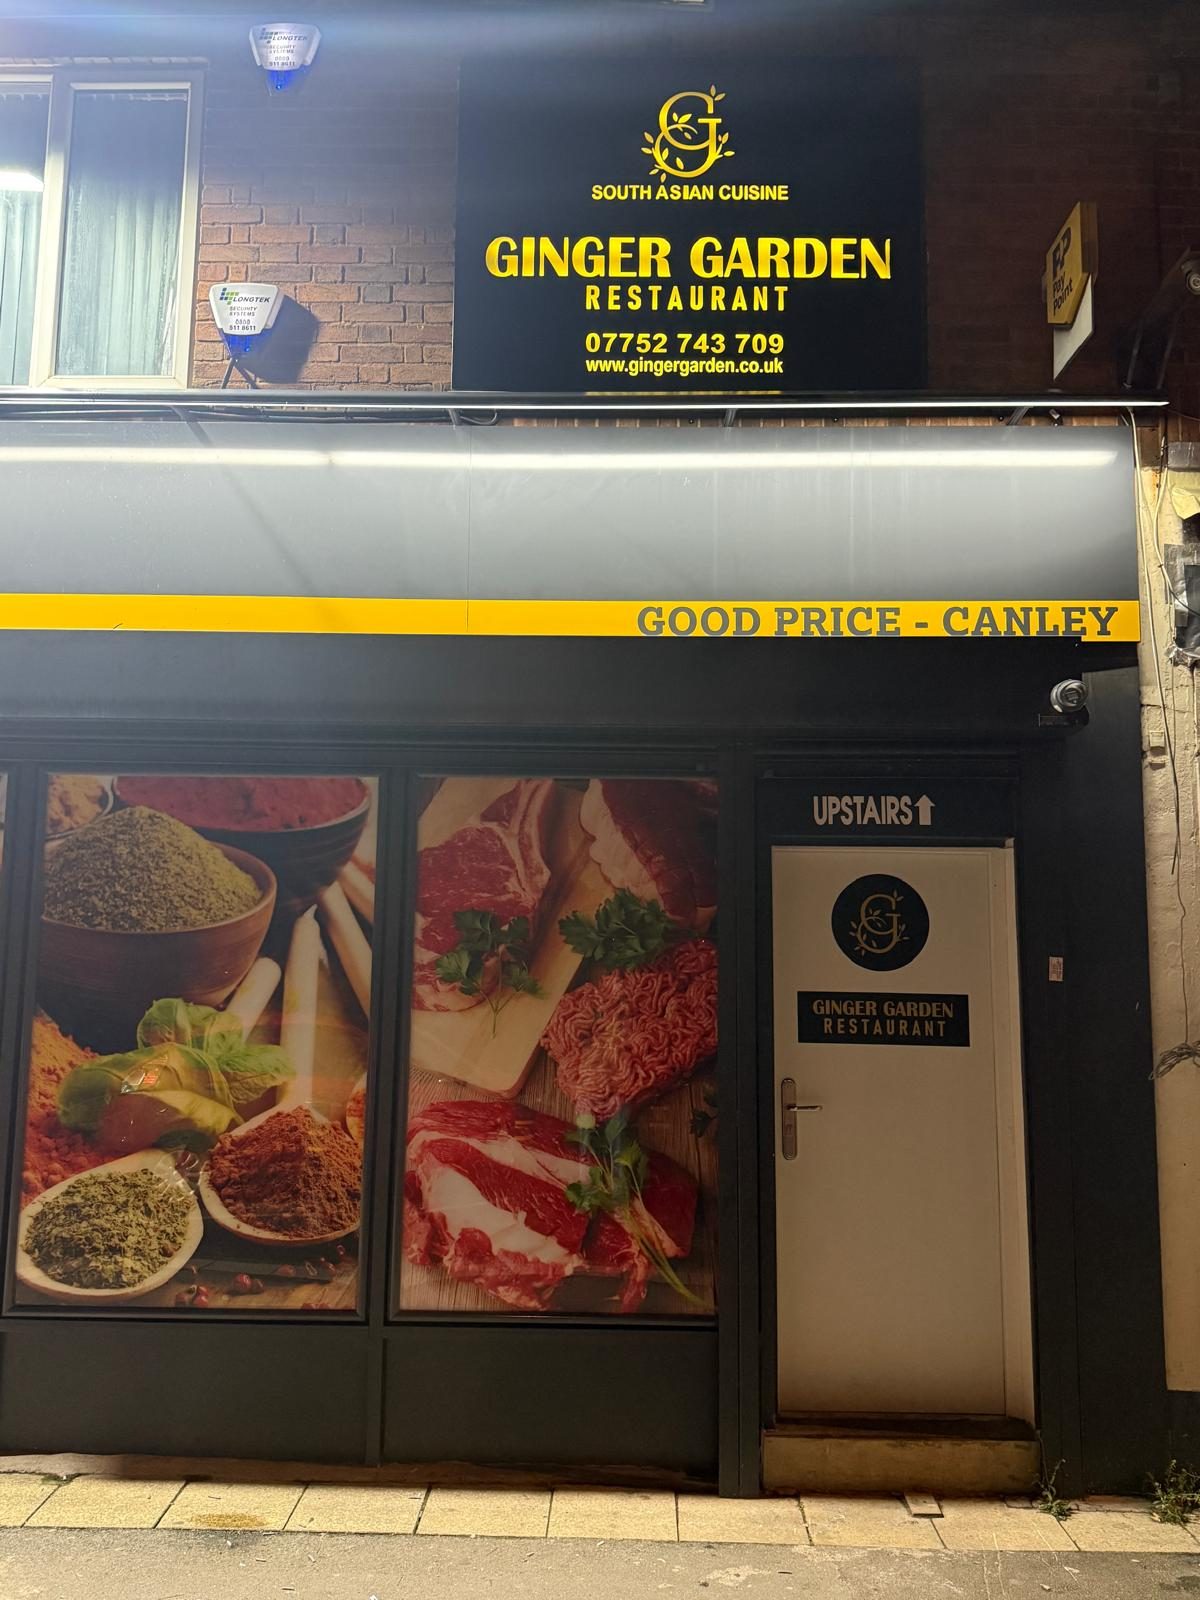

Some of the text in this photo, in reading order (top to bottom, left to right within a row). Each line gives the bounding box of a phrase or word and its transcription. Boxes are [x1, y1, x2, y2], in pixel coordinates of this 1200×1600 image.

[591, 184, 789, 201] SOUTH ASIAN CUISINE
[485, 236, 892, 280] GINGER GARDEN
[585, 285, 788, 312] RESTAURANT
[585, 333, 784, 355] 07752 743 709
[585, 357, 784, 377] www.gingergarden.co.uk
[637, 606, 761, 637] GOOD
[774, 606, 901, 637] PRICE
[942, 606, 1118, 637] CANLEY
[813, 795, 913, 826] UPSTAIRS
[812, 999, 954, 1018] GINGER GARDEN
[823, 1017, 946, 1038] RESTAURANT
